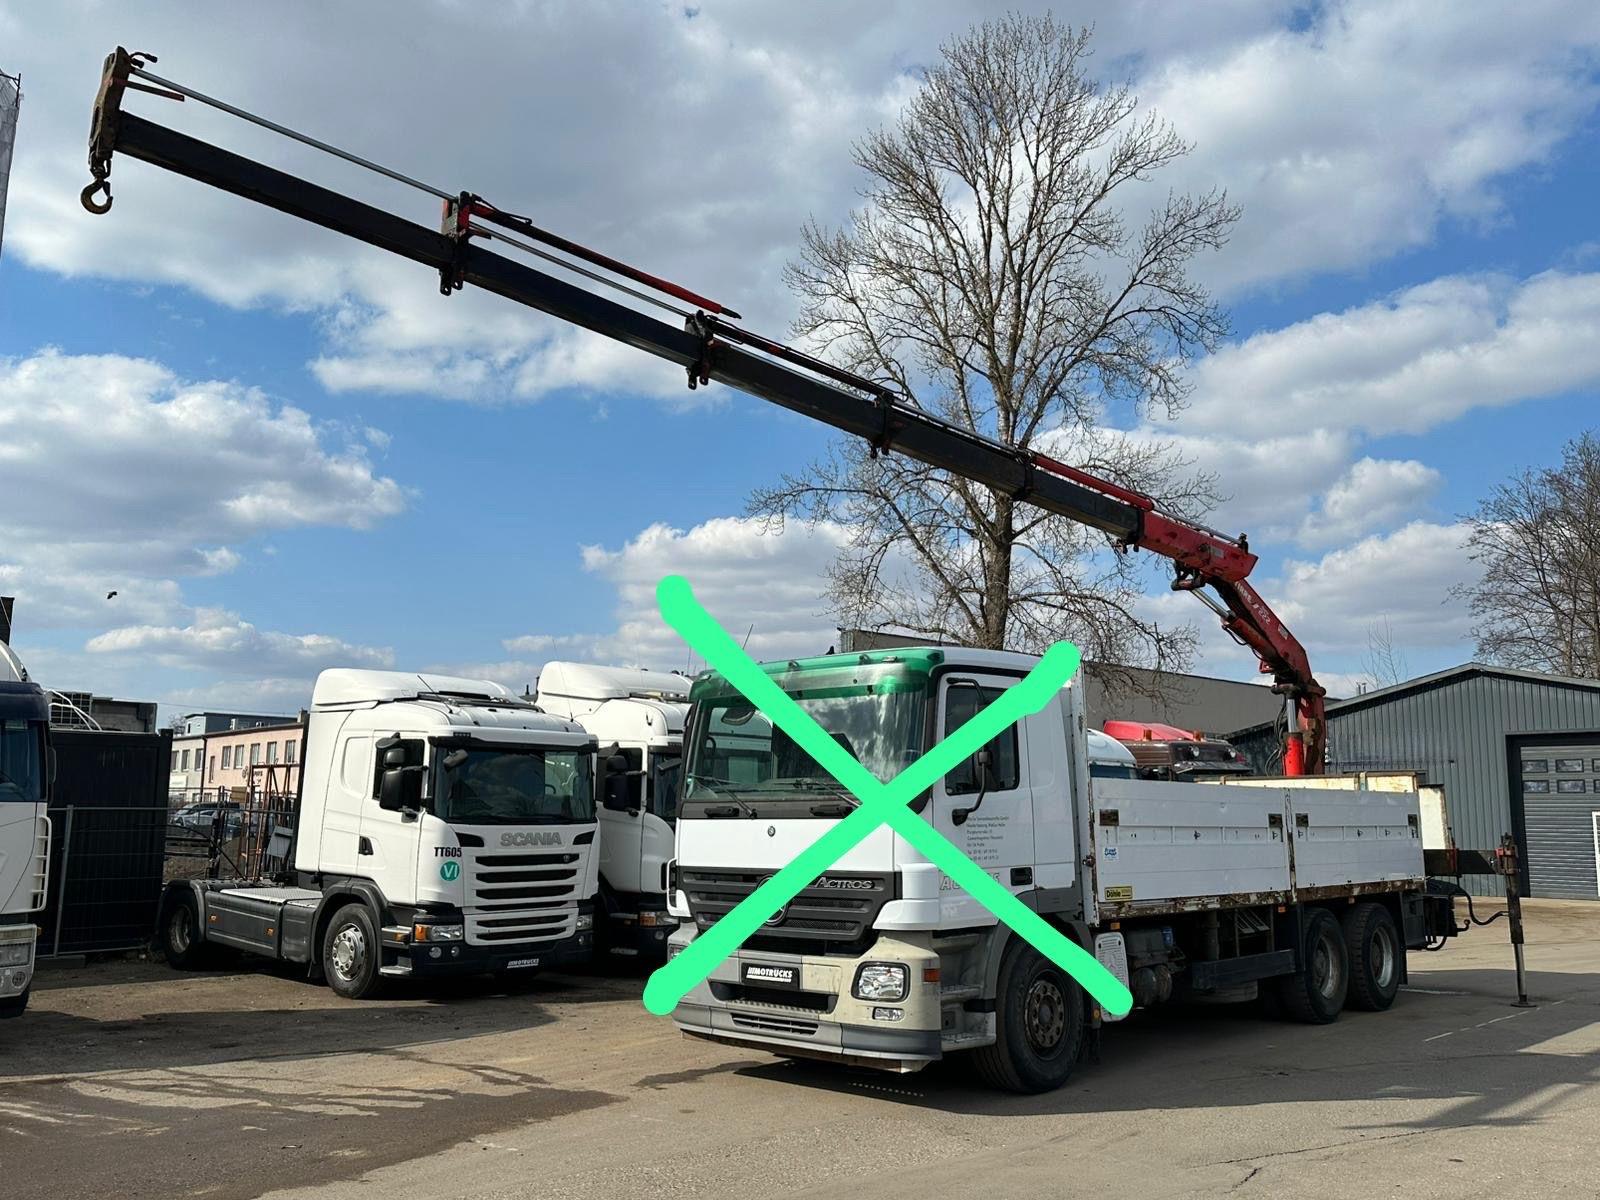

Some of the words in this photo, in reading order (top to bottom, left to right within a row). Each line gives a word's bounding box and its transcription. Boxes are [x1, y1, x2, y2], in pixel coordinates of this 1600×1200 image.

[500, 832, 562, 847] SCANIA
[434, 847, 462, 858] TT605
[443, 864, 458, 878] VI
[815, 876, 873, 889] ACTROS
